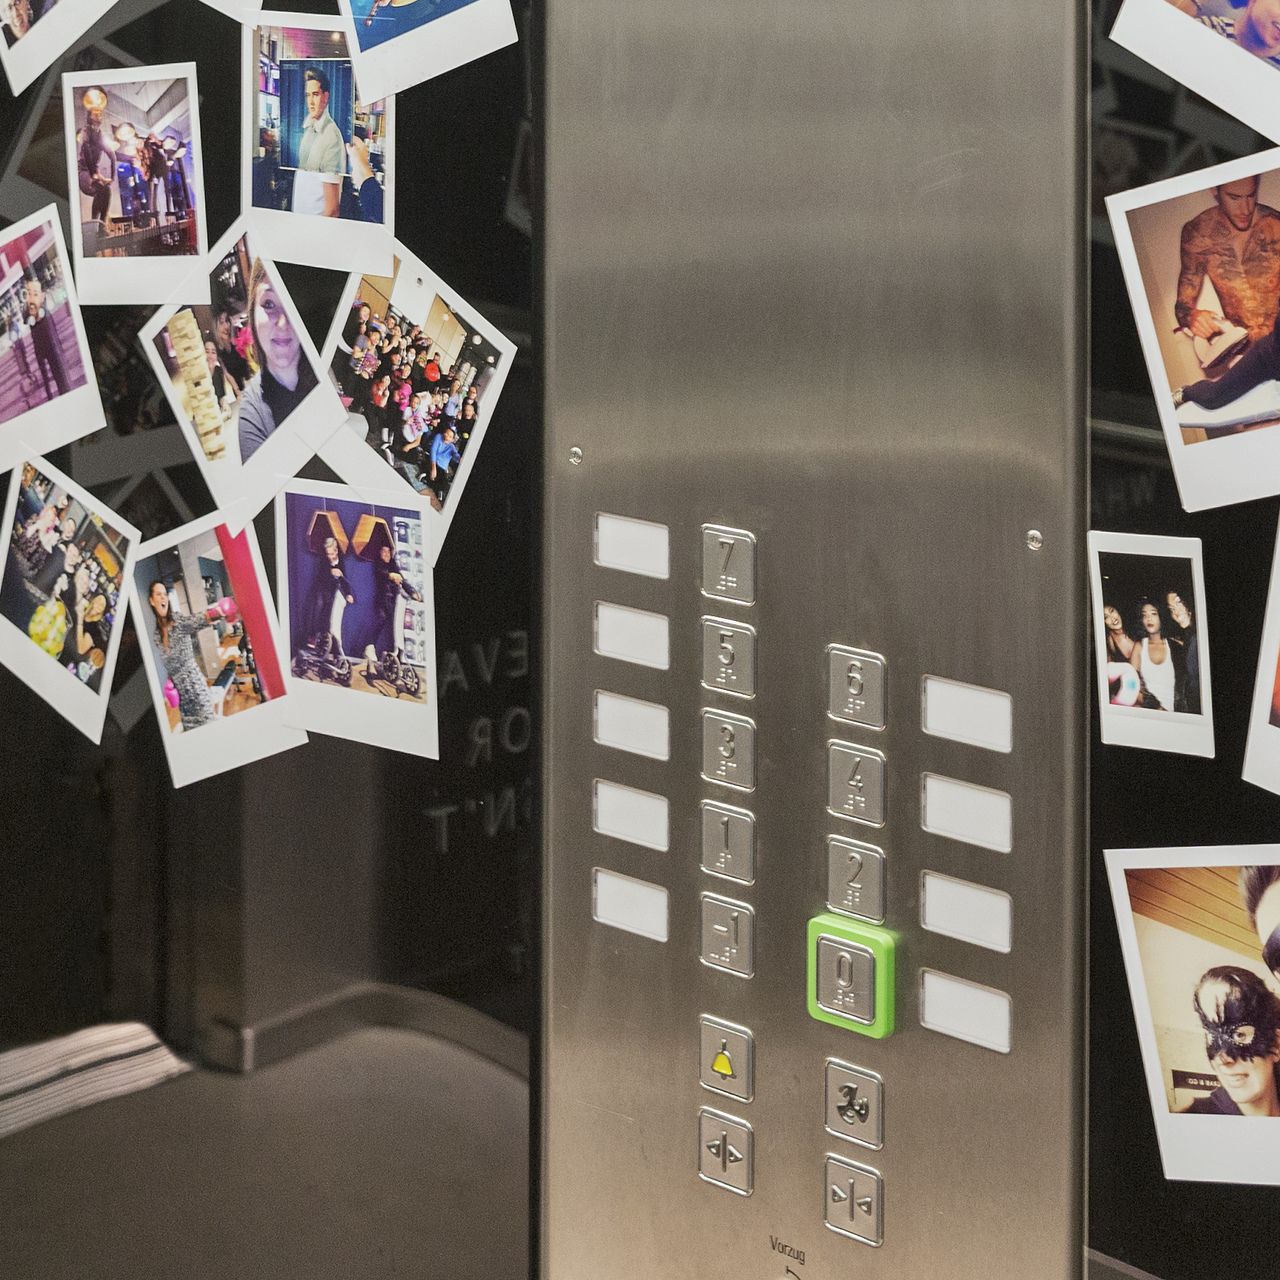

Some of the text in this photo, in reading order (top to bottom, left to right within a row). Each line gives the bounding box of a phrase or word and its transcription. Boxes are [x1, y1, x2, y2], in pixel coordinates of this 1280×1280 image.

[718, 539, 735, 574] 7
[718, 631, 735, 665] 5
[846, 661, 864, 696] 6
[718, 726, 735, 759] 3
[847, 757, 863, 792] 4
[720, 817, 731, 851] 1
[846, 853, 864, 888] 2
[711, 912, 740, 948] -1
[835, 951, 853, 989] 0
[769, 1235, 806, 1266] Vorzug
